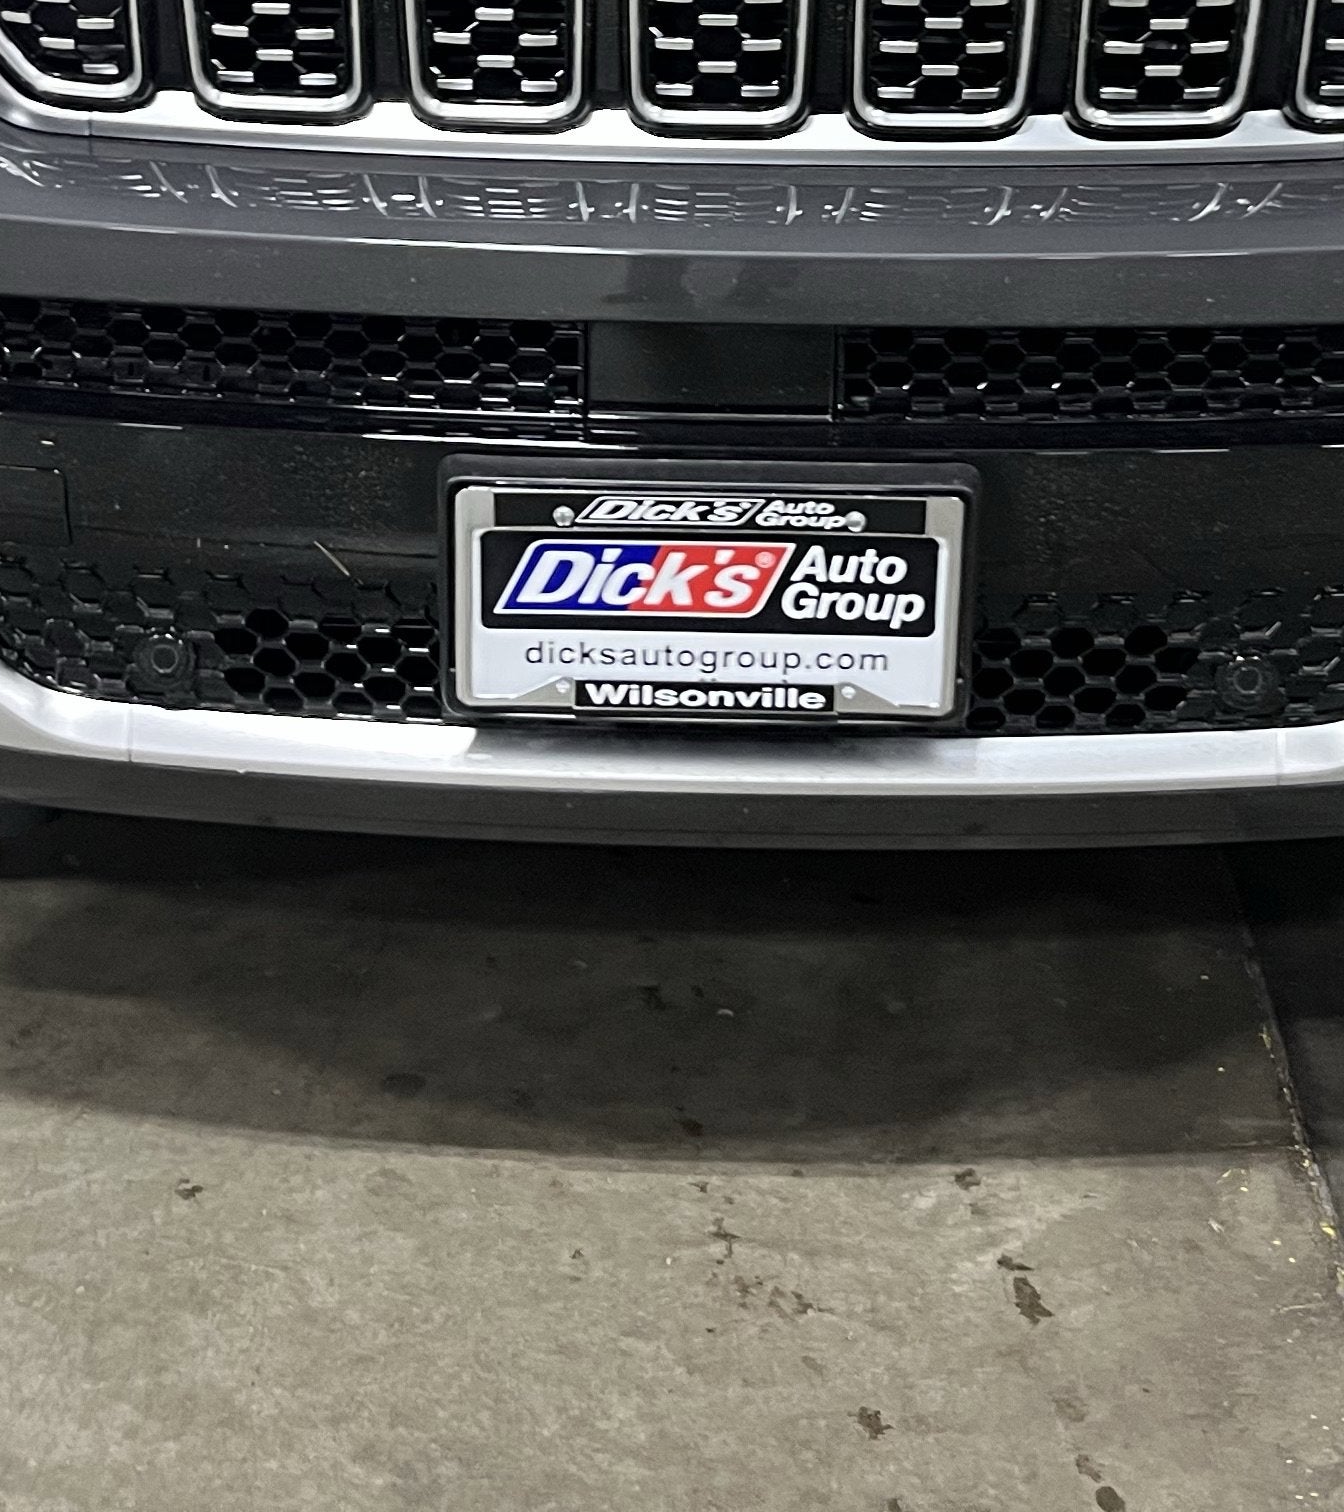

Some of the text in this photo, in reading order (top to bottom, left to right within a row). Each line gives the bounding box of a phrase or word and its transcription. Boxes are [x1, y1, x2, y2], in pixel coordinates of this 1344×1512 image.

[588, 498, 742, 523] Dick's
[755, 512, 848, 530] Group
[762, 499, 836, 515] Auto
[515, 547, 761, 608] Dick's
[789, 544, 908, 585] Auto
[780, 581, 926, 630] Group
[524, 641, 889, 674] dicksautogroup.com
[584, 682, 827, 710] Wilsonville
